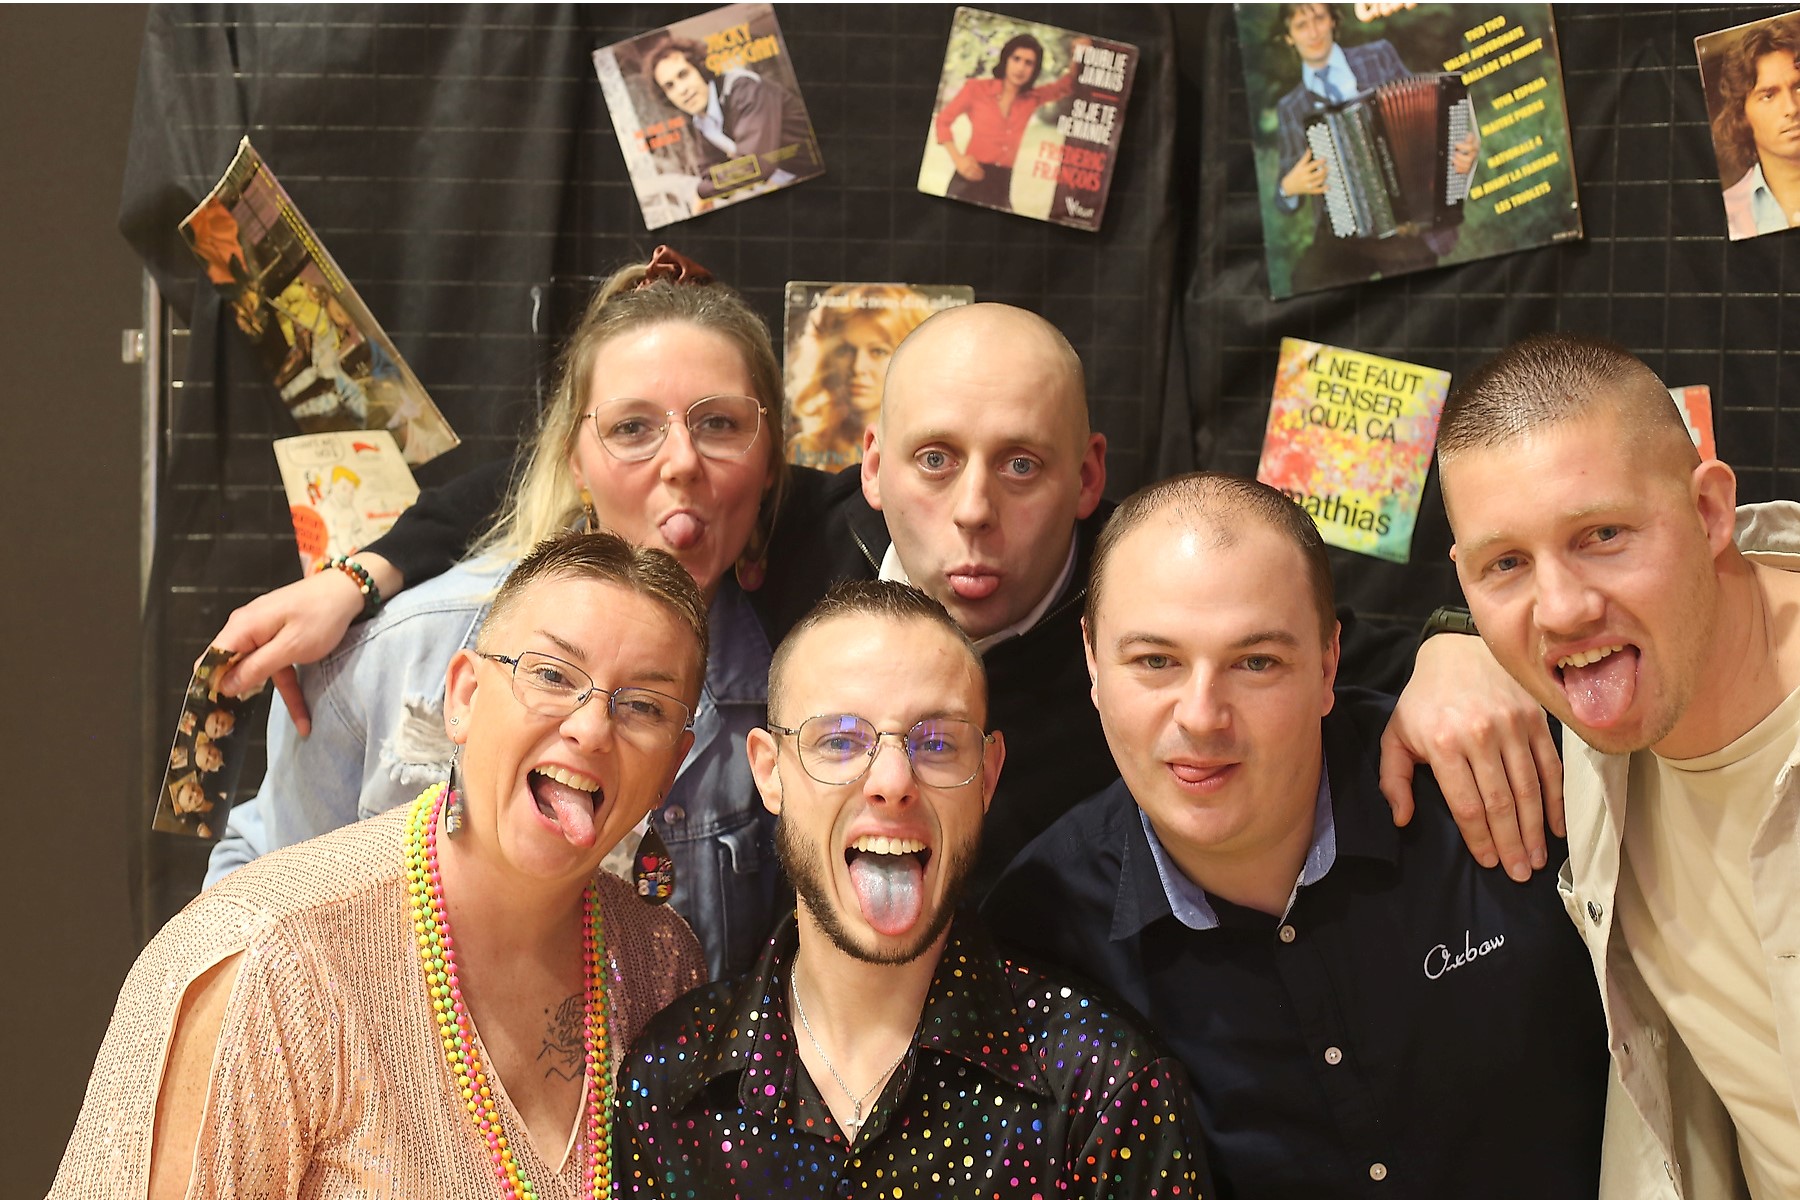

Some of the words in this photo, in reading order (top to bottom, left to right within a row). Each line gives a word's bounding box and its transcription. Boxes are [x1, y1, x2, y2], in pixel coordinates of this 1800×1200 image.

[1078, 66, 1124, 92] JAMAIS
[1307, 353, 1324, 375] IL
[1329, 357, 1360, 381] NE
[1364, 365, 1423, 395] FAUT
[1315, 380, 1403, 418] PENSER
[1423, 929, 1505, 980] Oxbow
